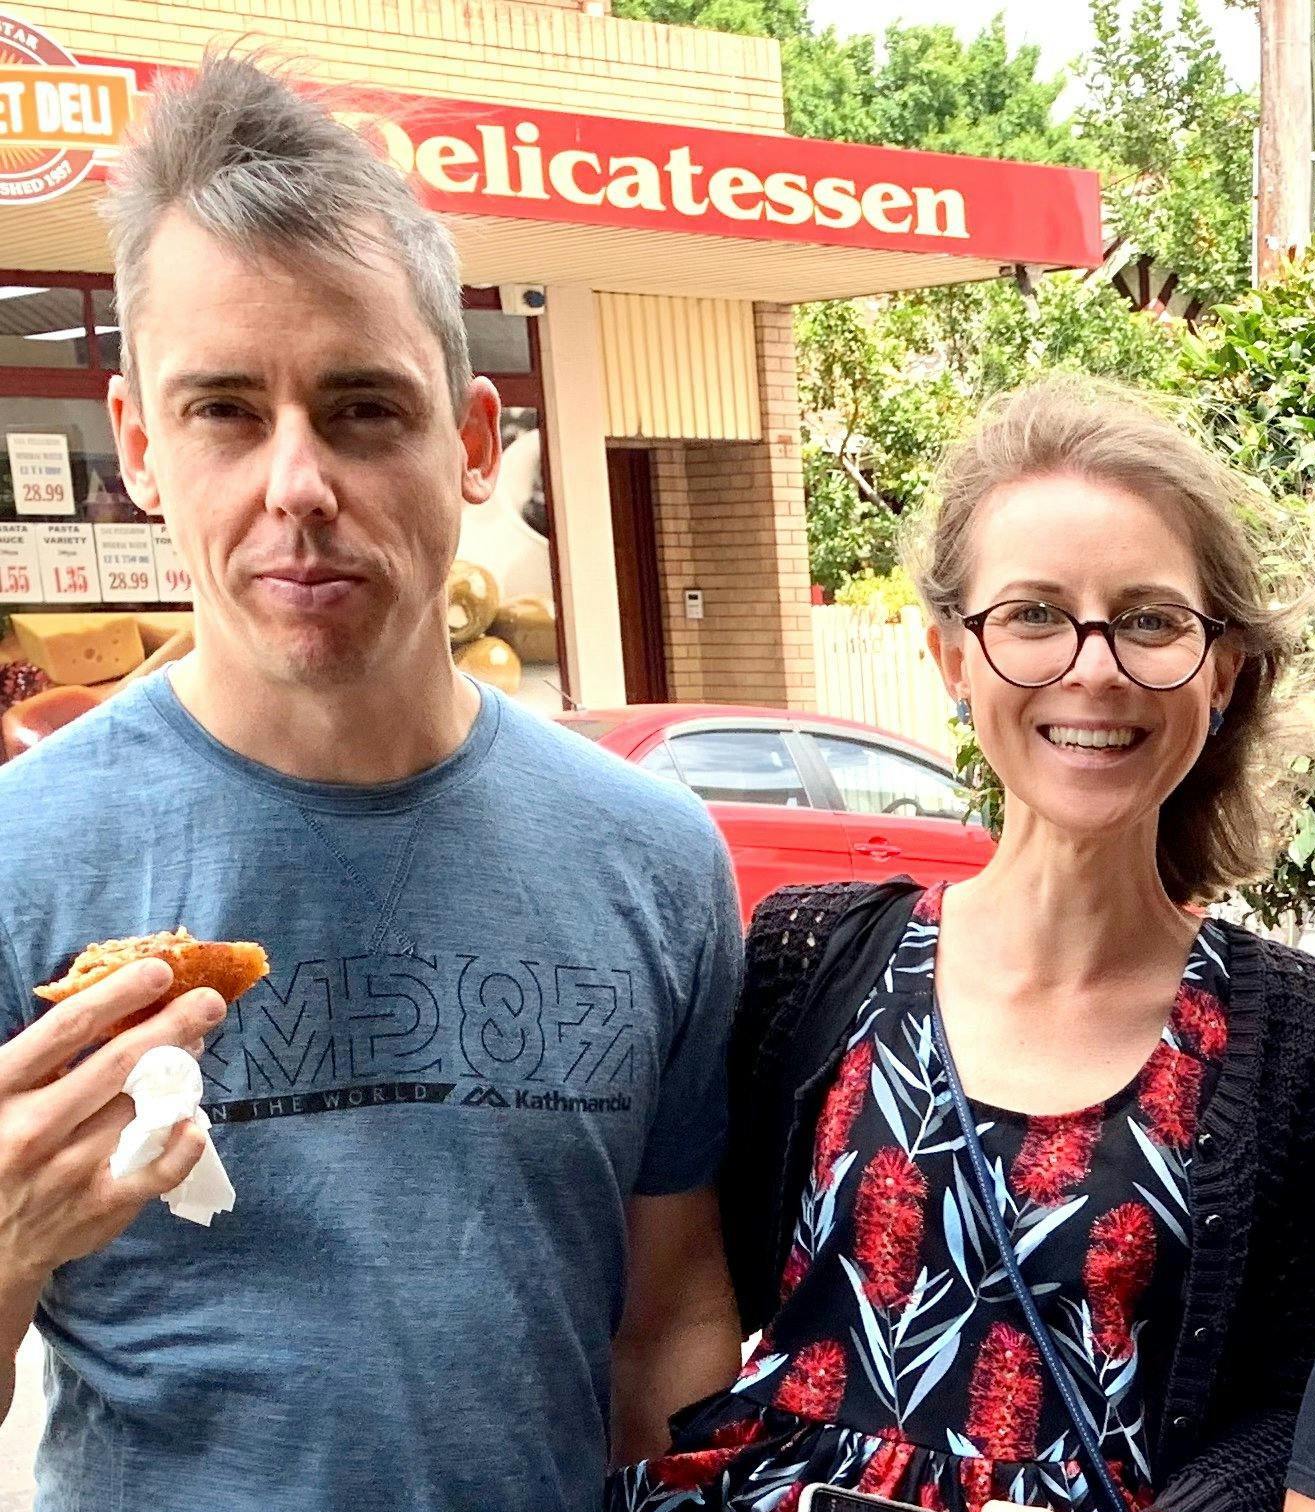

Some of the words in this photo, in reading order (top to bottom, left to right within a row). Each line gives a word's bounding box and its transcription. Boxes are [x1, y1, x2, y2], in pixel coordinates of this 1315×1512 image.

[0, 20, 39, 51] TAR
[34, 81, 112, 136] DELI
[23, 483, 64, 502] 28.99
[48, 525, 80, 533] PASTA
[43, 536, 87, 545] VARIETY
[108, 571, 149, 590] 28.99
[251, 1099, 304, 1118] THE
[322, 1084, 428, 1109] WORLD
[514, 1088, 632, 1114] Kathmandu
